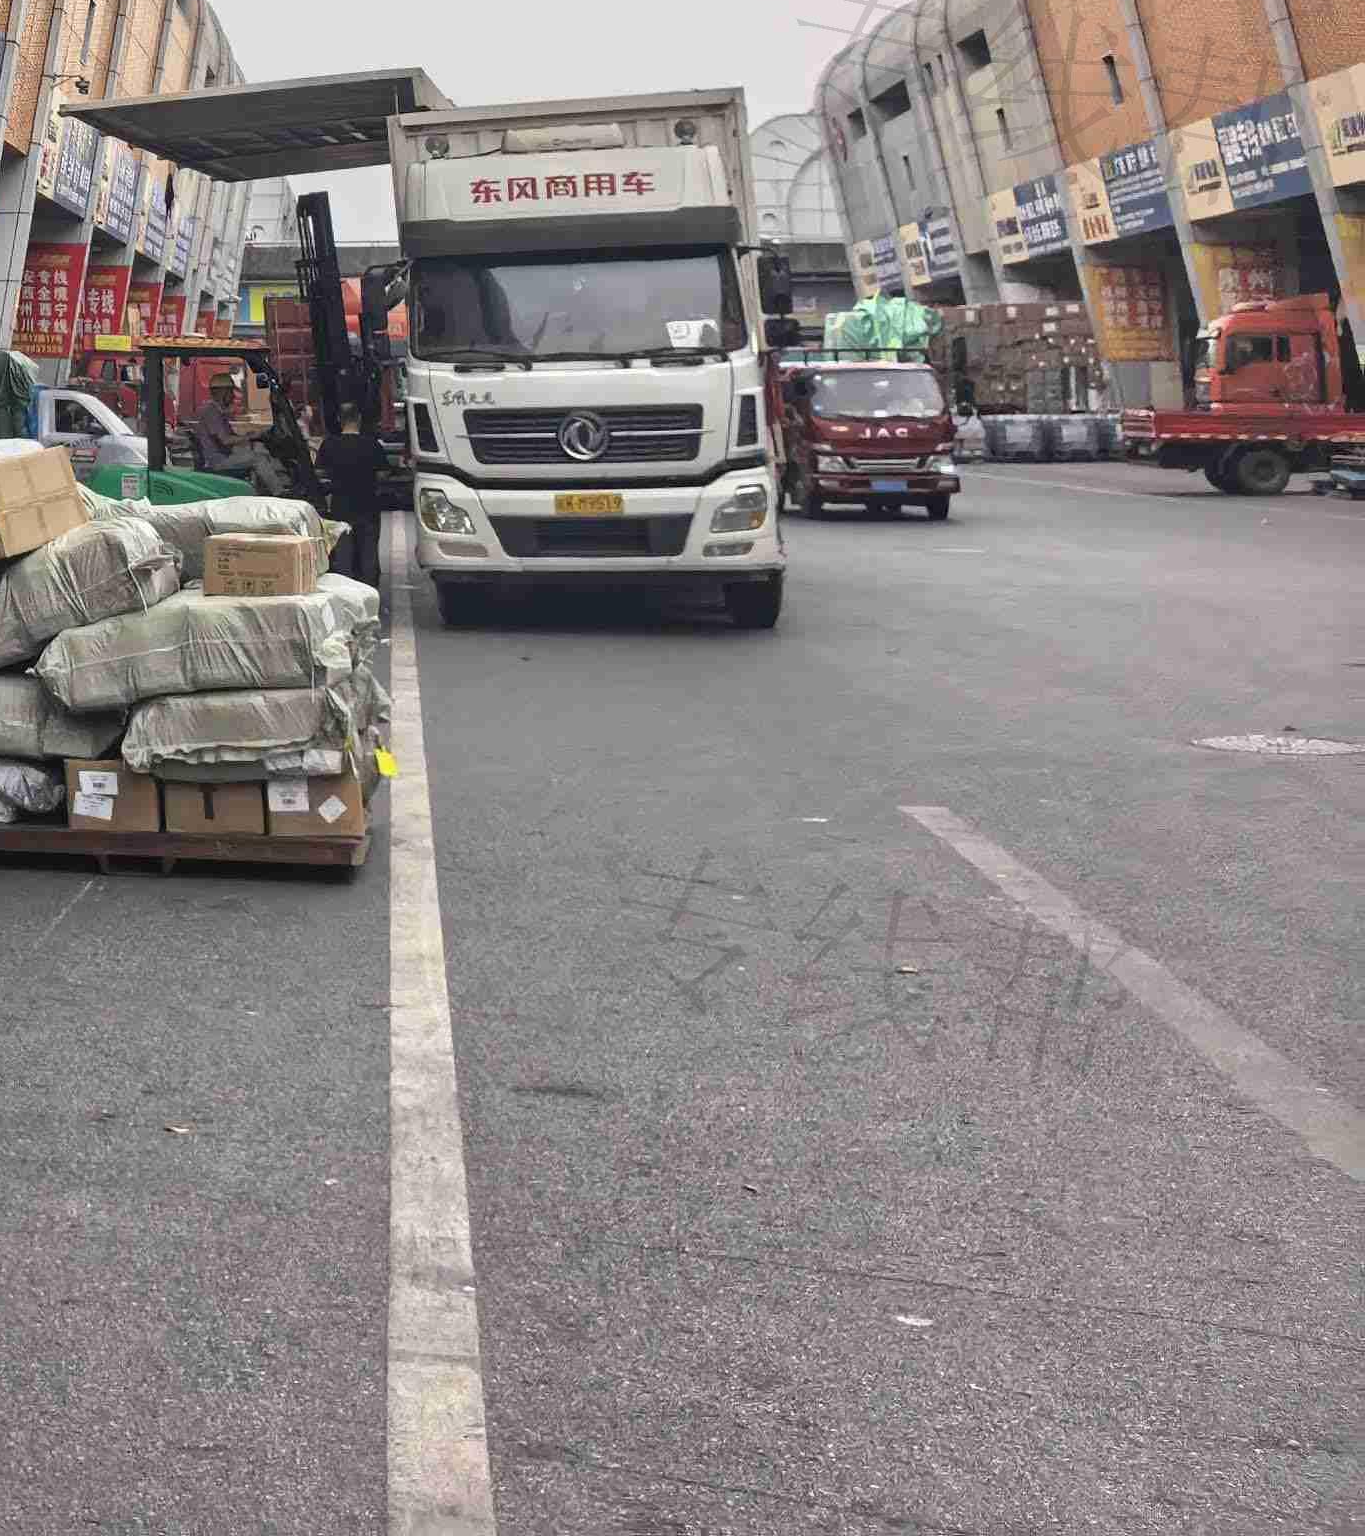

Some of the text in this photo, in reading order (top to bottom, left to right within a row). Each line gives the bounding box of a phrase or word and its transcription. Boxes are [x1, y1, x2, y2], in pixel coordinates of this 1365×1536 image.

[470, 171, 655, 204] 东风商用车
[857, 427, 909, 440] JAC
